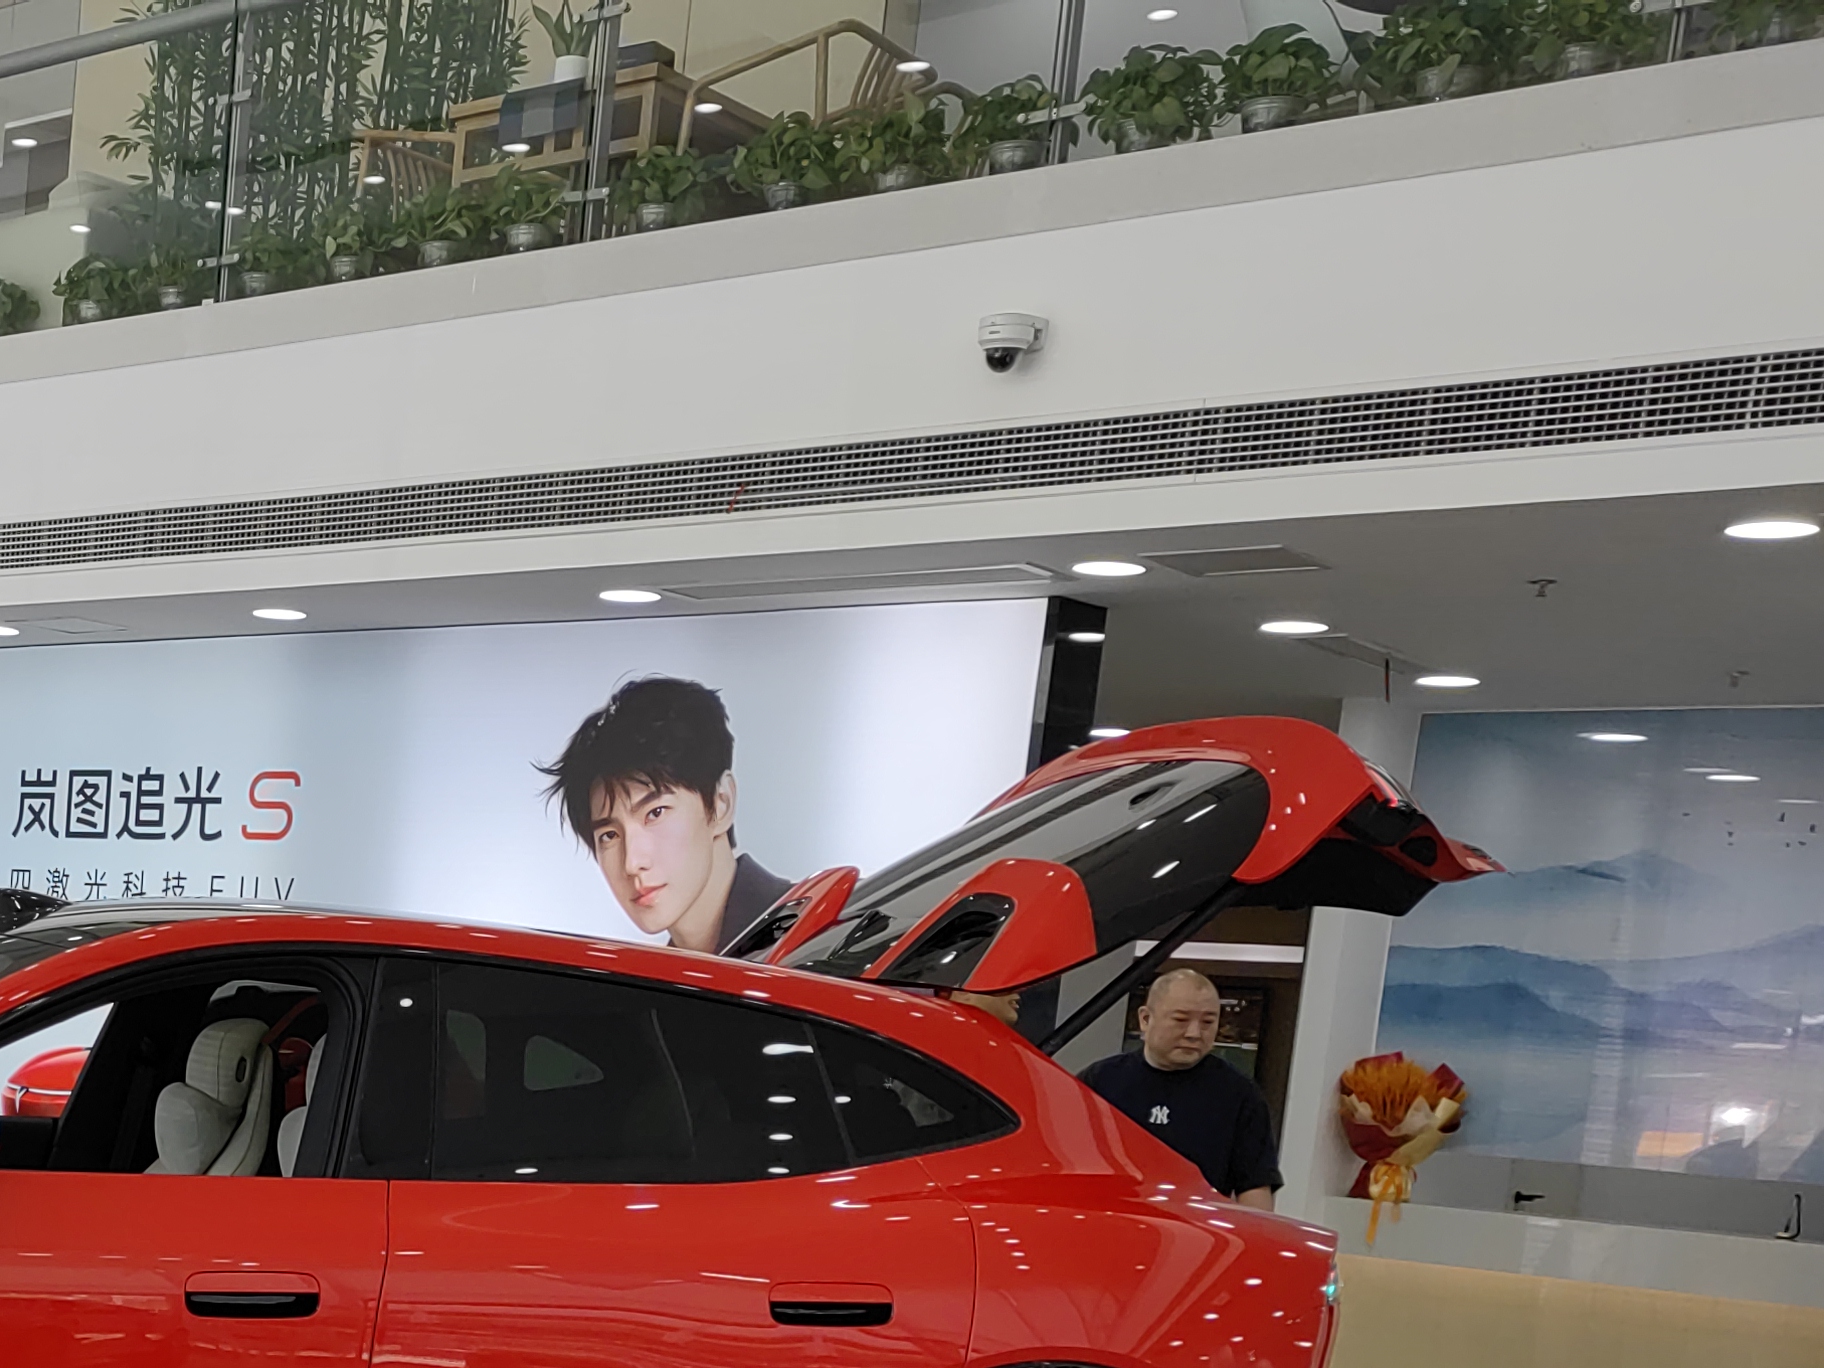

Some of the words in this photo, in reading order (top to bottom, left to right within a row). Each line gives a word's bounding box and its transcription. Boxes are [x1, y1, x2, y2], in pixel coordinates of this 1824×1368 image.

[11, 765, 224, 842] 岚图追光
[240, 770, 302, 841] S
